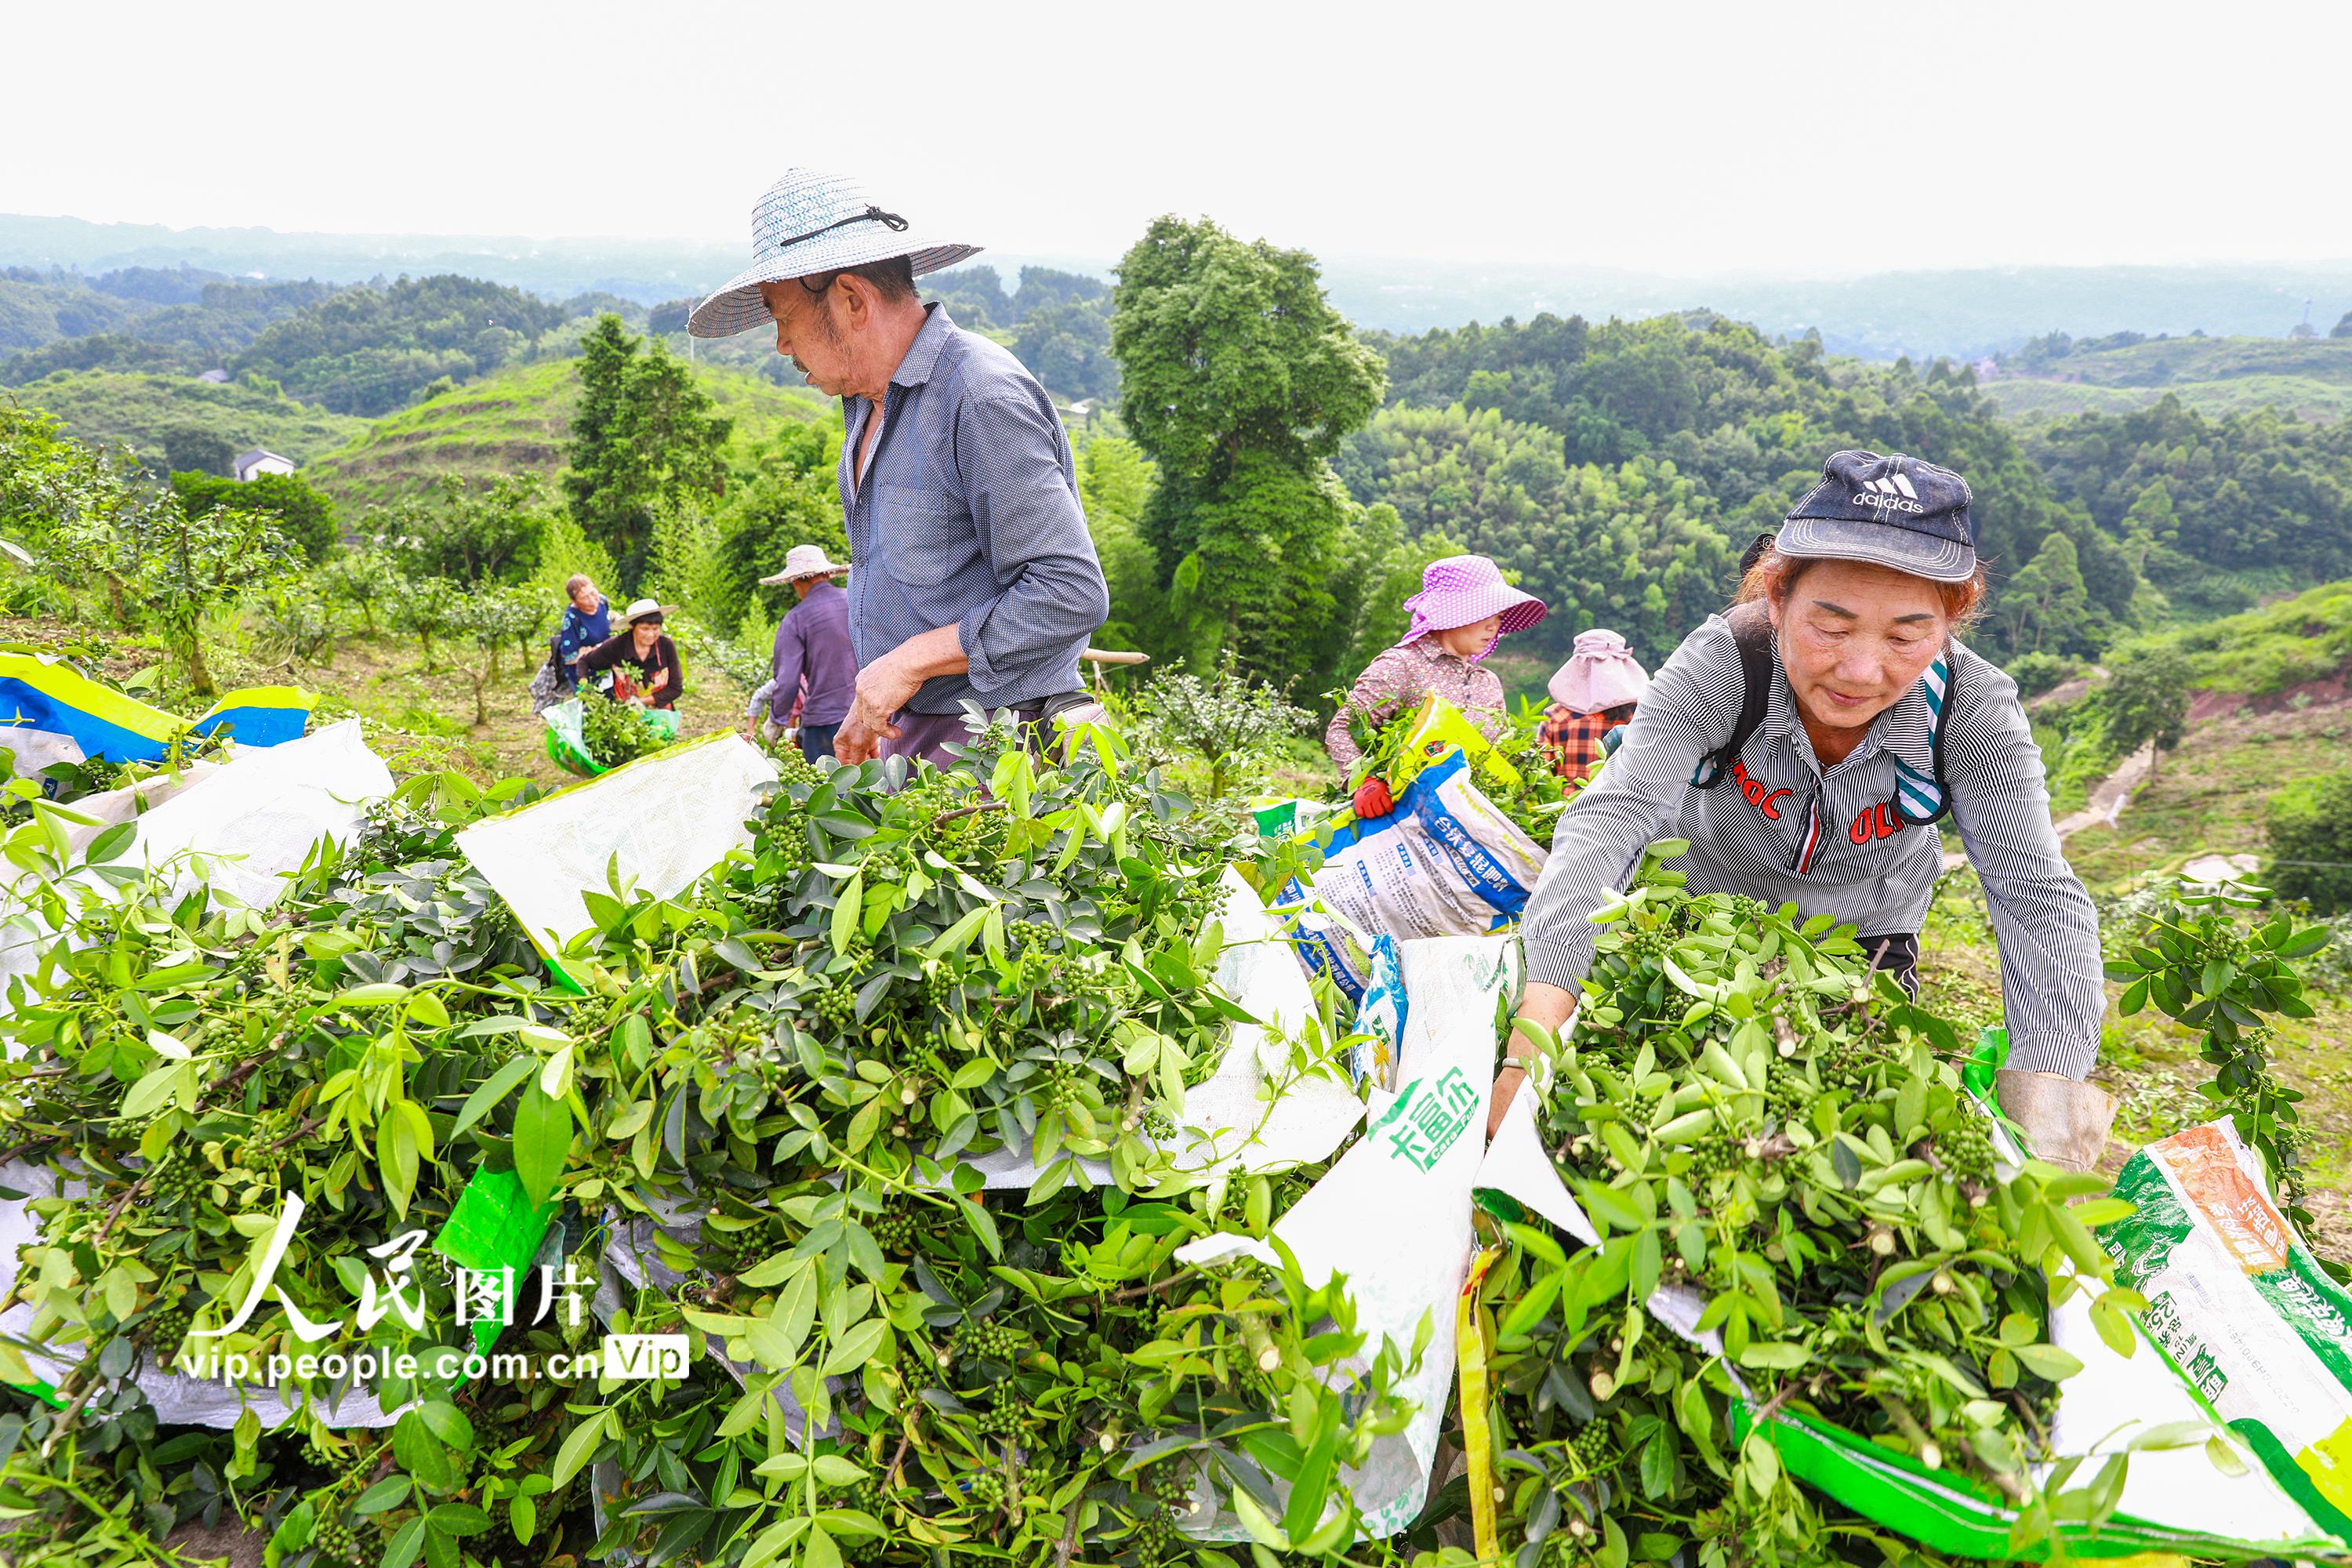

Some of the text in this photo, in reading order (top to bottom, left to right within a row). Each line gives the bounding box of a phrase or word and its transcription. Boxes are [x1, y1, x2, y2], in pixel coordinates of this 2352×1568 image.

[1434, 815, 1513, 893] 台沃复混肥料
